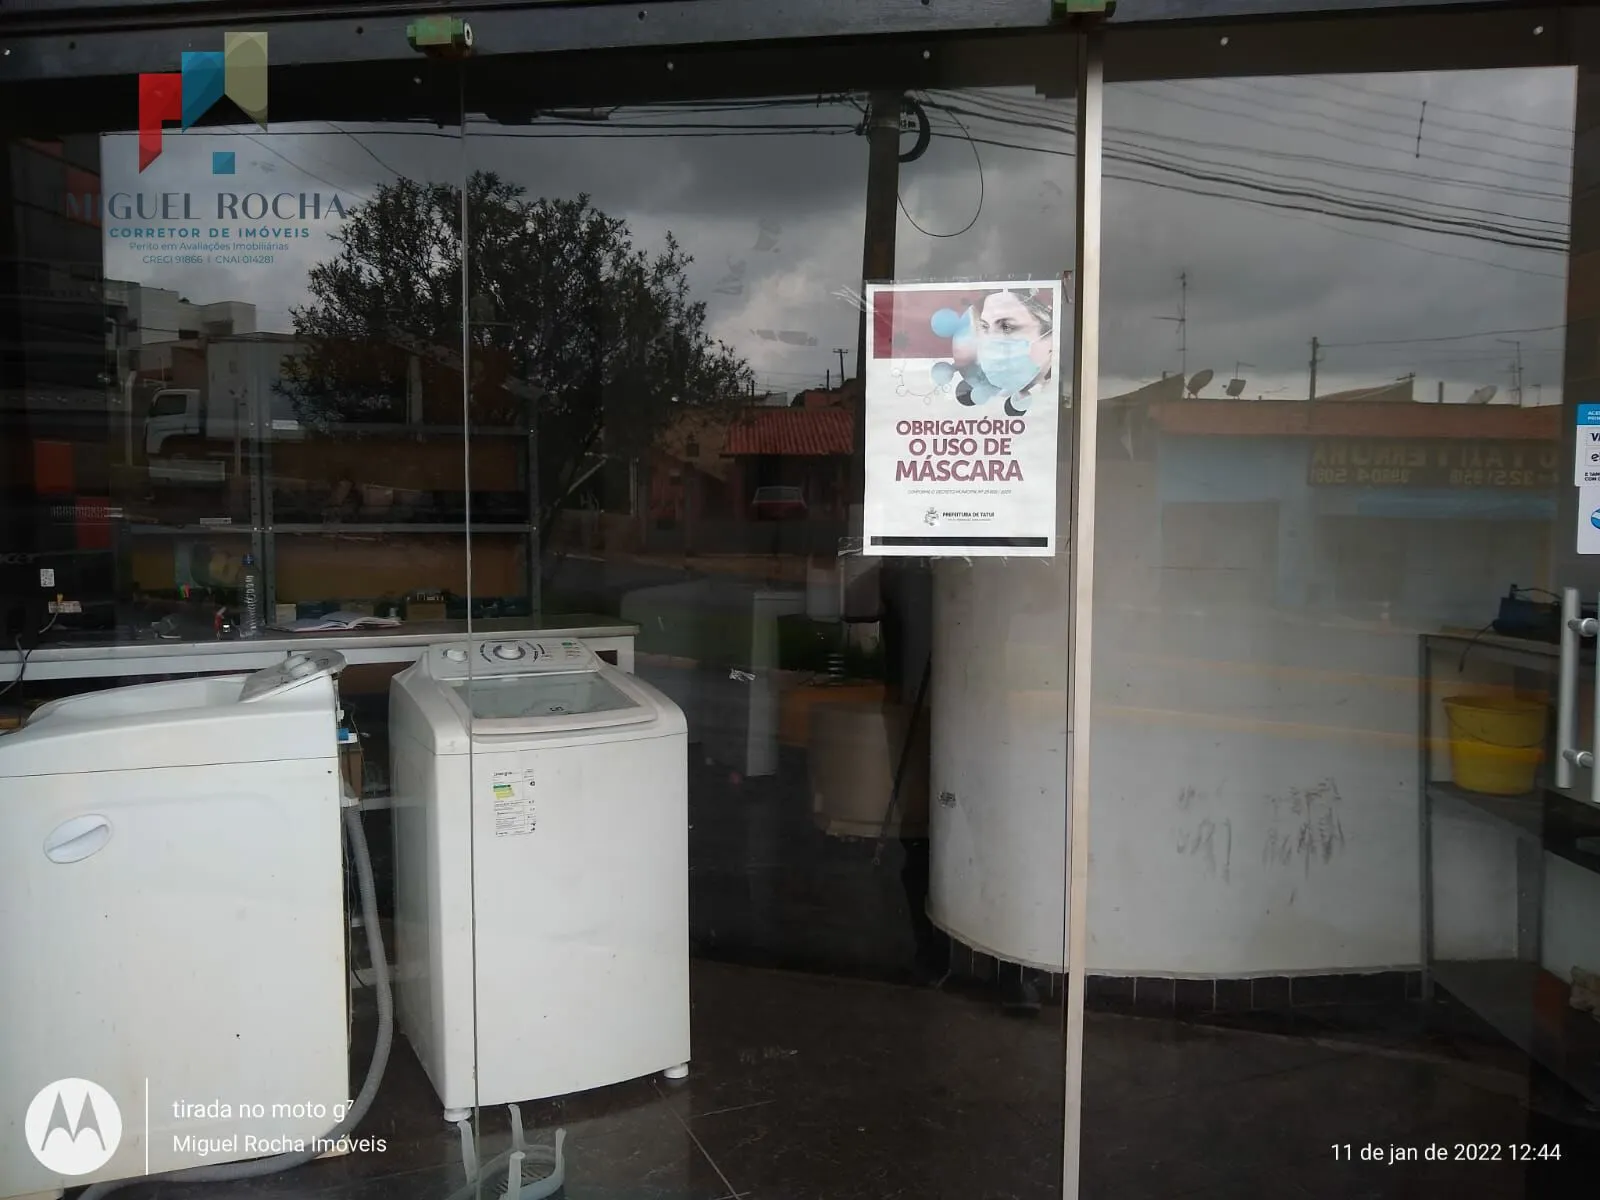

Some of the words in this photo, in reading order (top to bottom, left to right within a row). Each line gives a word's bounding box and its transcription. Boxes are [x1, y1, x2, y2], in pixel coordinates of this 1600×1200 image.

[895, 416, 1026, 436] OBRIGATÓRIO
[908, 438, 927, 456] O
[932, 438, 978, 456] USO
[983, 437, 1012, 456] DE
[895, 454, 1025, 482] MÁSCARA
